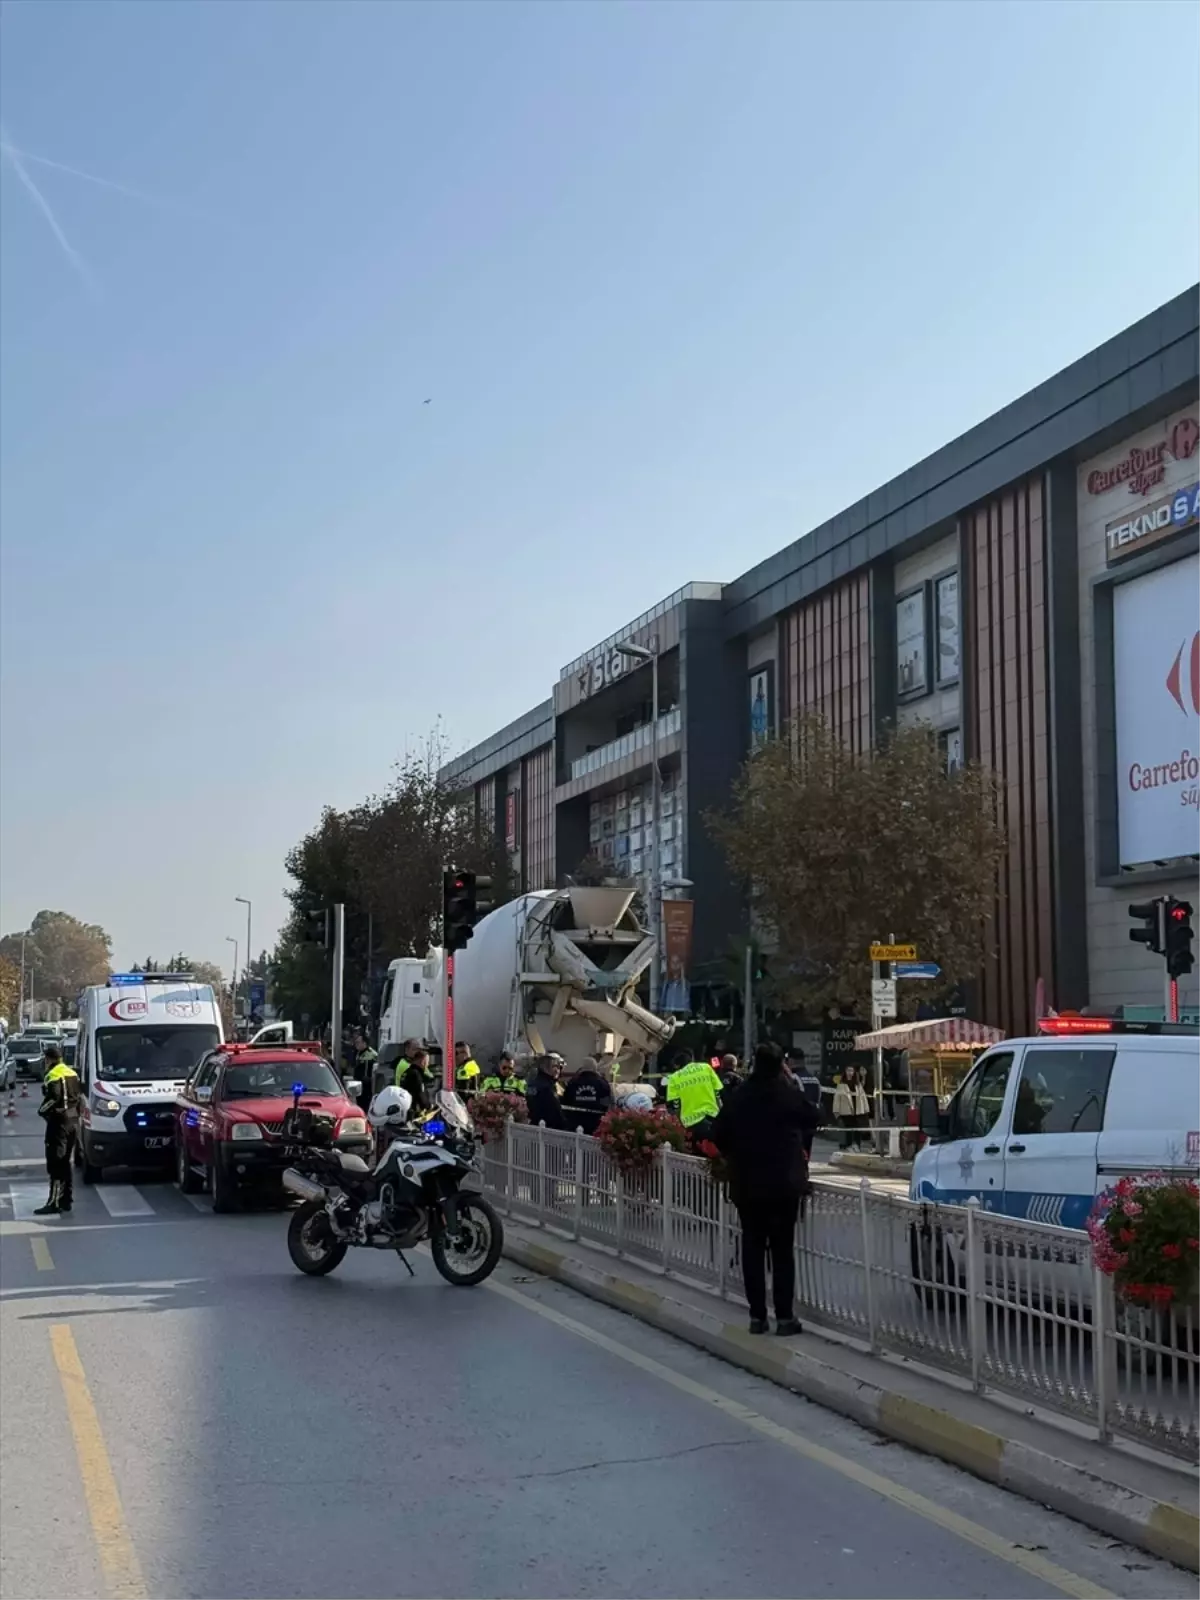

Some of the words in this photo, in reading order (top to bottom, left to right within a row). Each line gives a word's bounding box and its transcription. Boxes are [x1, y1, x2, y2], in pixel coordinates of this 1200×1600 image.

[1129, 749, 1200, 792] Carrefo
[832, 1029, 863, 1040] KAPA
[826, 1041, 854, 1051] OTOP
